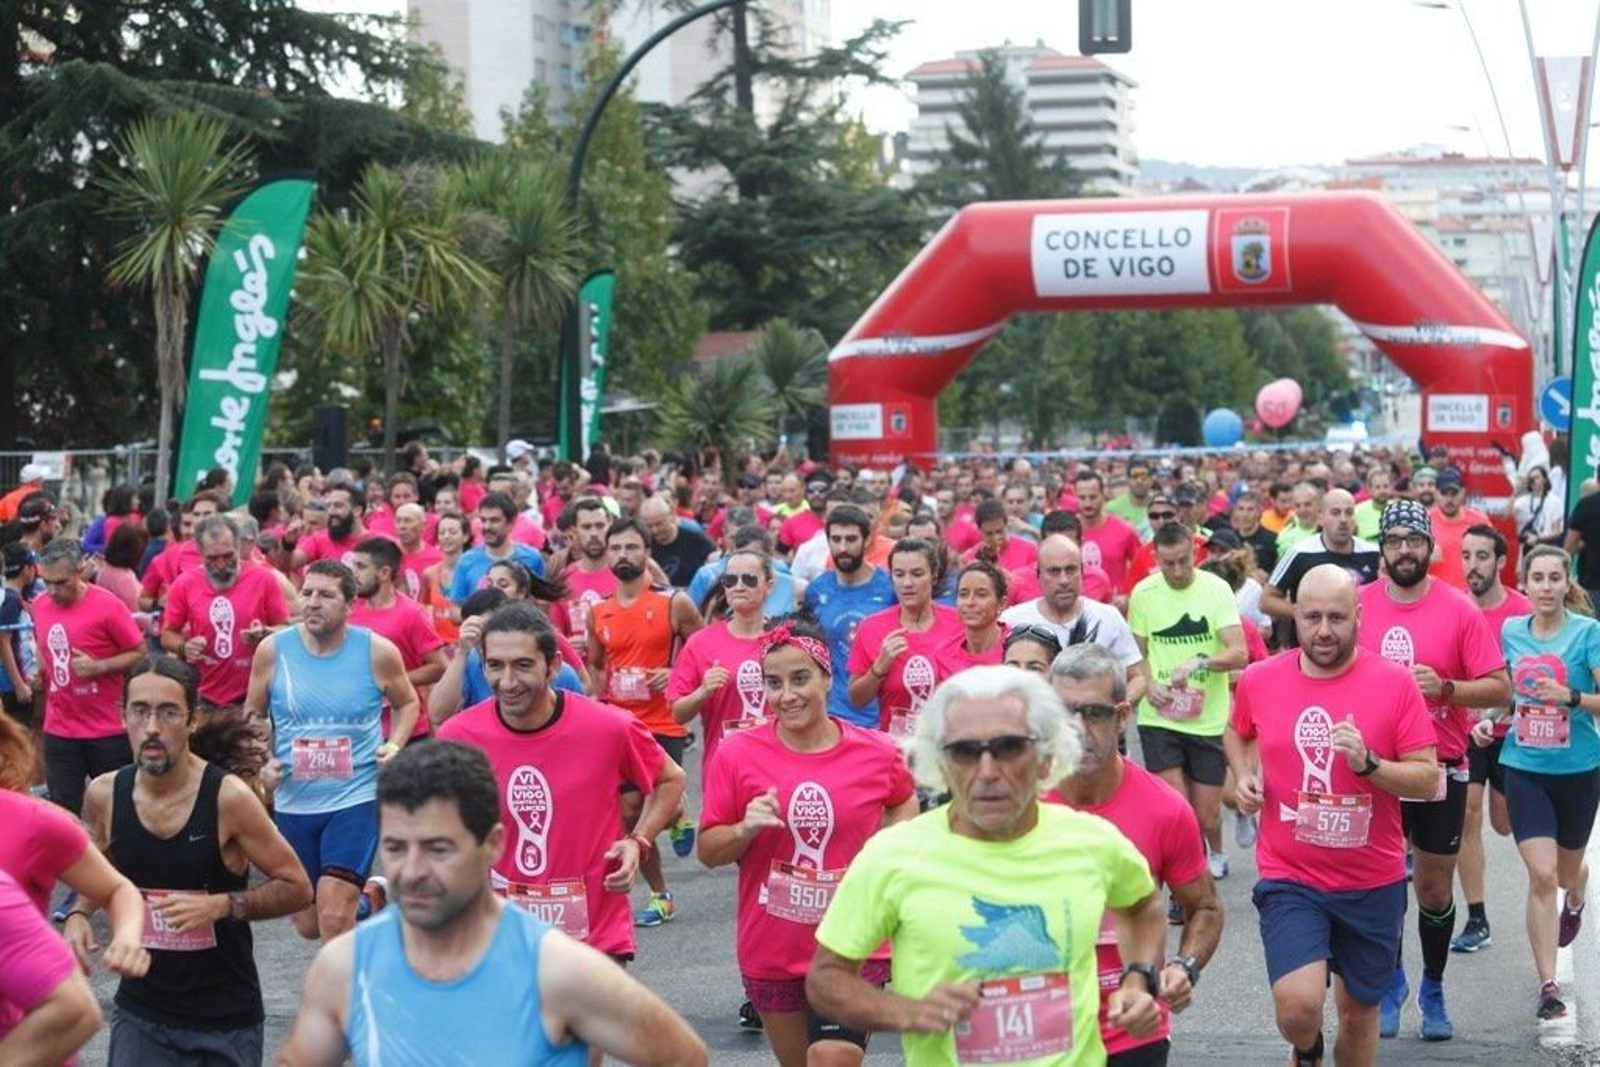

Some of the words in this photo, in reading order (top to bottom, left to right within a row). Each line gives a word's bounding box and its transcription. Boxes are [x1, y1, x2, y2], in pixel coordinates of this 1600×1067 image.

[1045, 227, 1192, 251] CONCELLO
[1063, 258, 1099, 279] DE
[1108, 256, 1175, 278] VIGO
[199, 233, 278, 394] Inglés
[1301, 728, 1329, 737] VIGO
[1529, 719, 1554, 738] 976
[308, 749, 335, 769] 284
[518, 773, 534, 785] VI
[513, 790, 544, 799] VIGO
[803, 789, 818, 801] VI
[795, 806, 827, 816] VIGO
[1317, 811, 1351, 832] 575
[789, 884, 828, 909] 950
[995, 1002, 1034, 1039] 141
